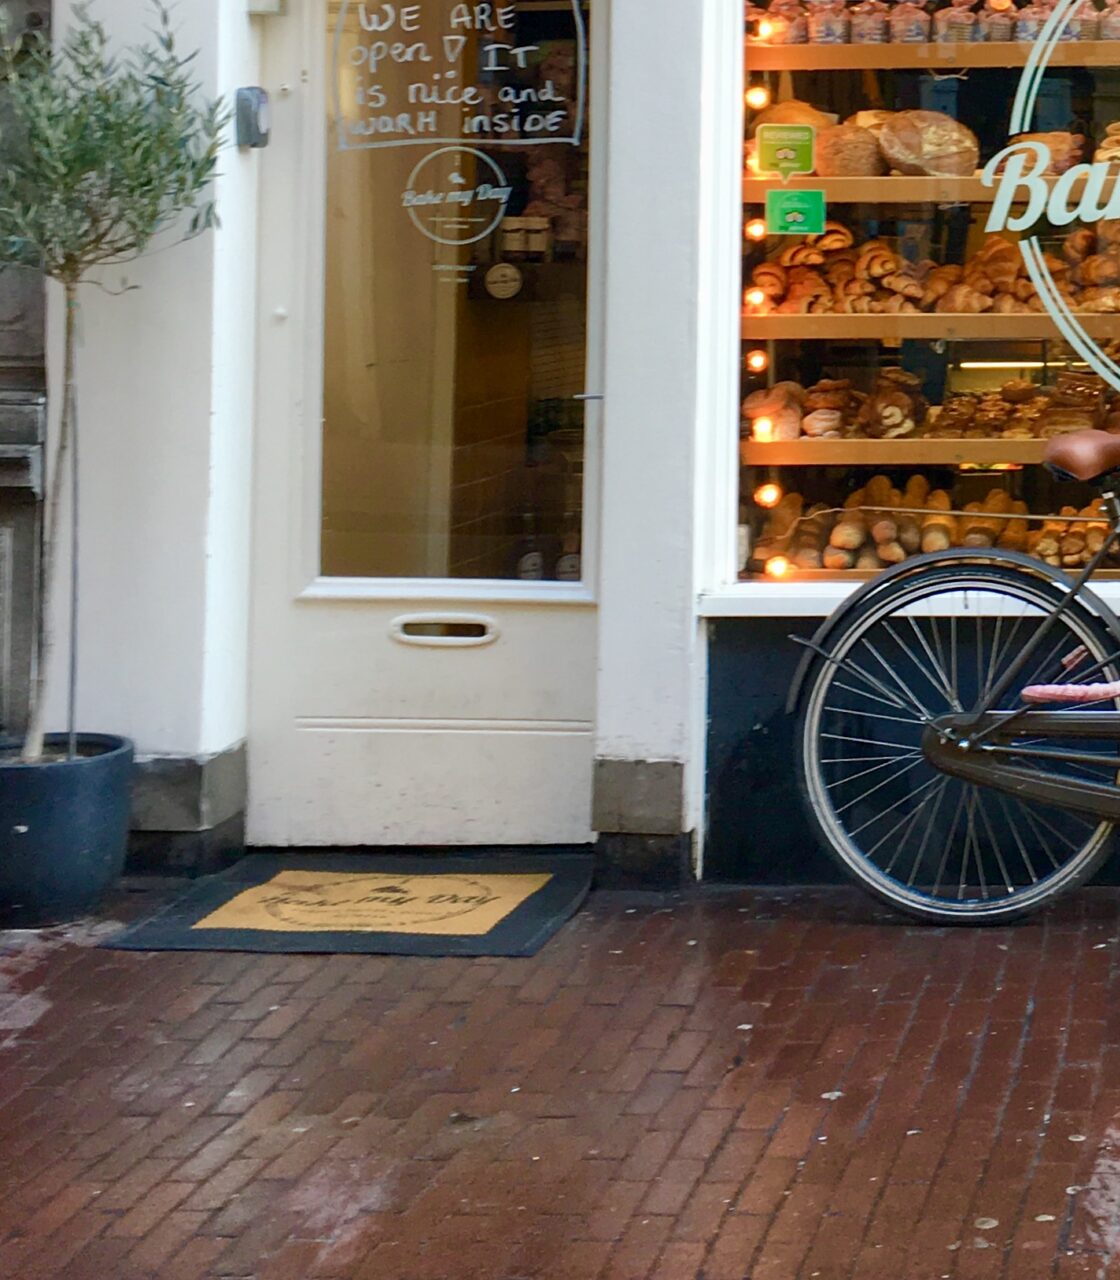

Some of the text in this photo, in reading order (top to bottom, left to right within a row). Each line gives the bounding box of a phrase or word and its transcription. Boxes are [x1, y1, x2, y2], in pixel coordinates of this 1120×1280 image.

[358, 3, 516, 31] WE ARE
[350, 41, 539, 73] open IT
[408, 72, 482, 104] nice
[498, 80, 565, 103] and
